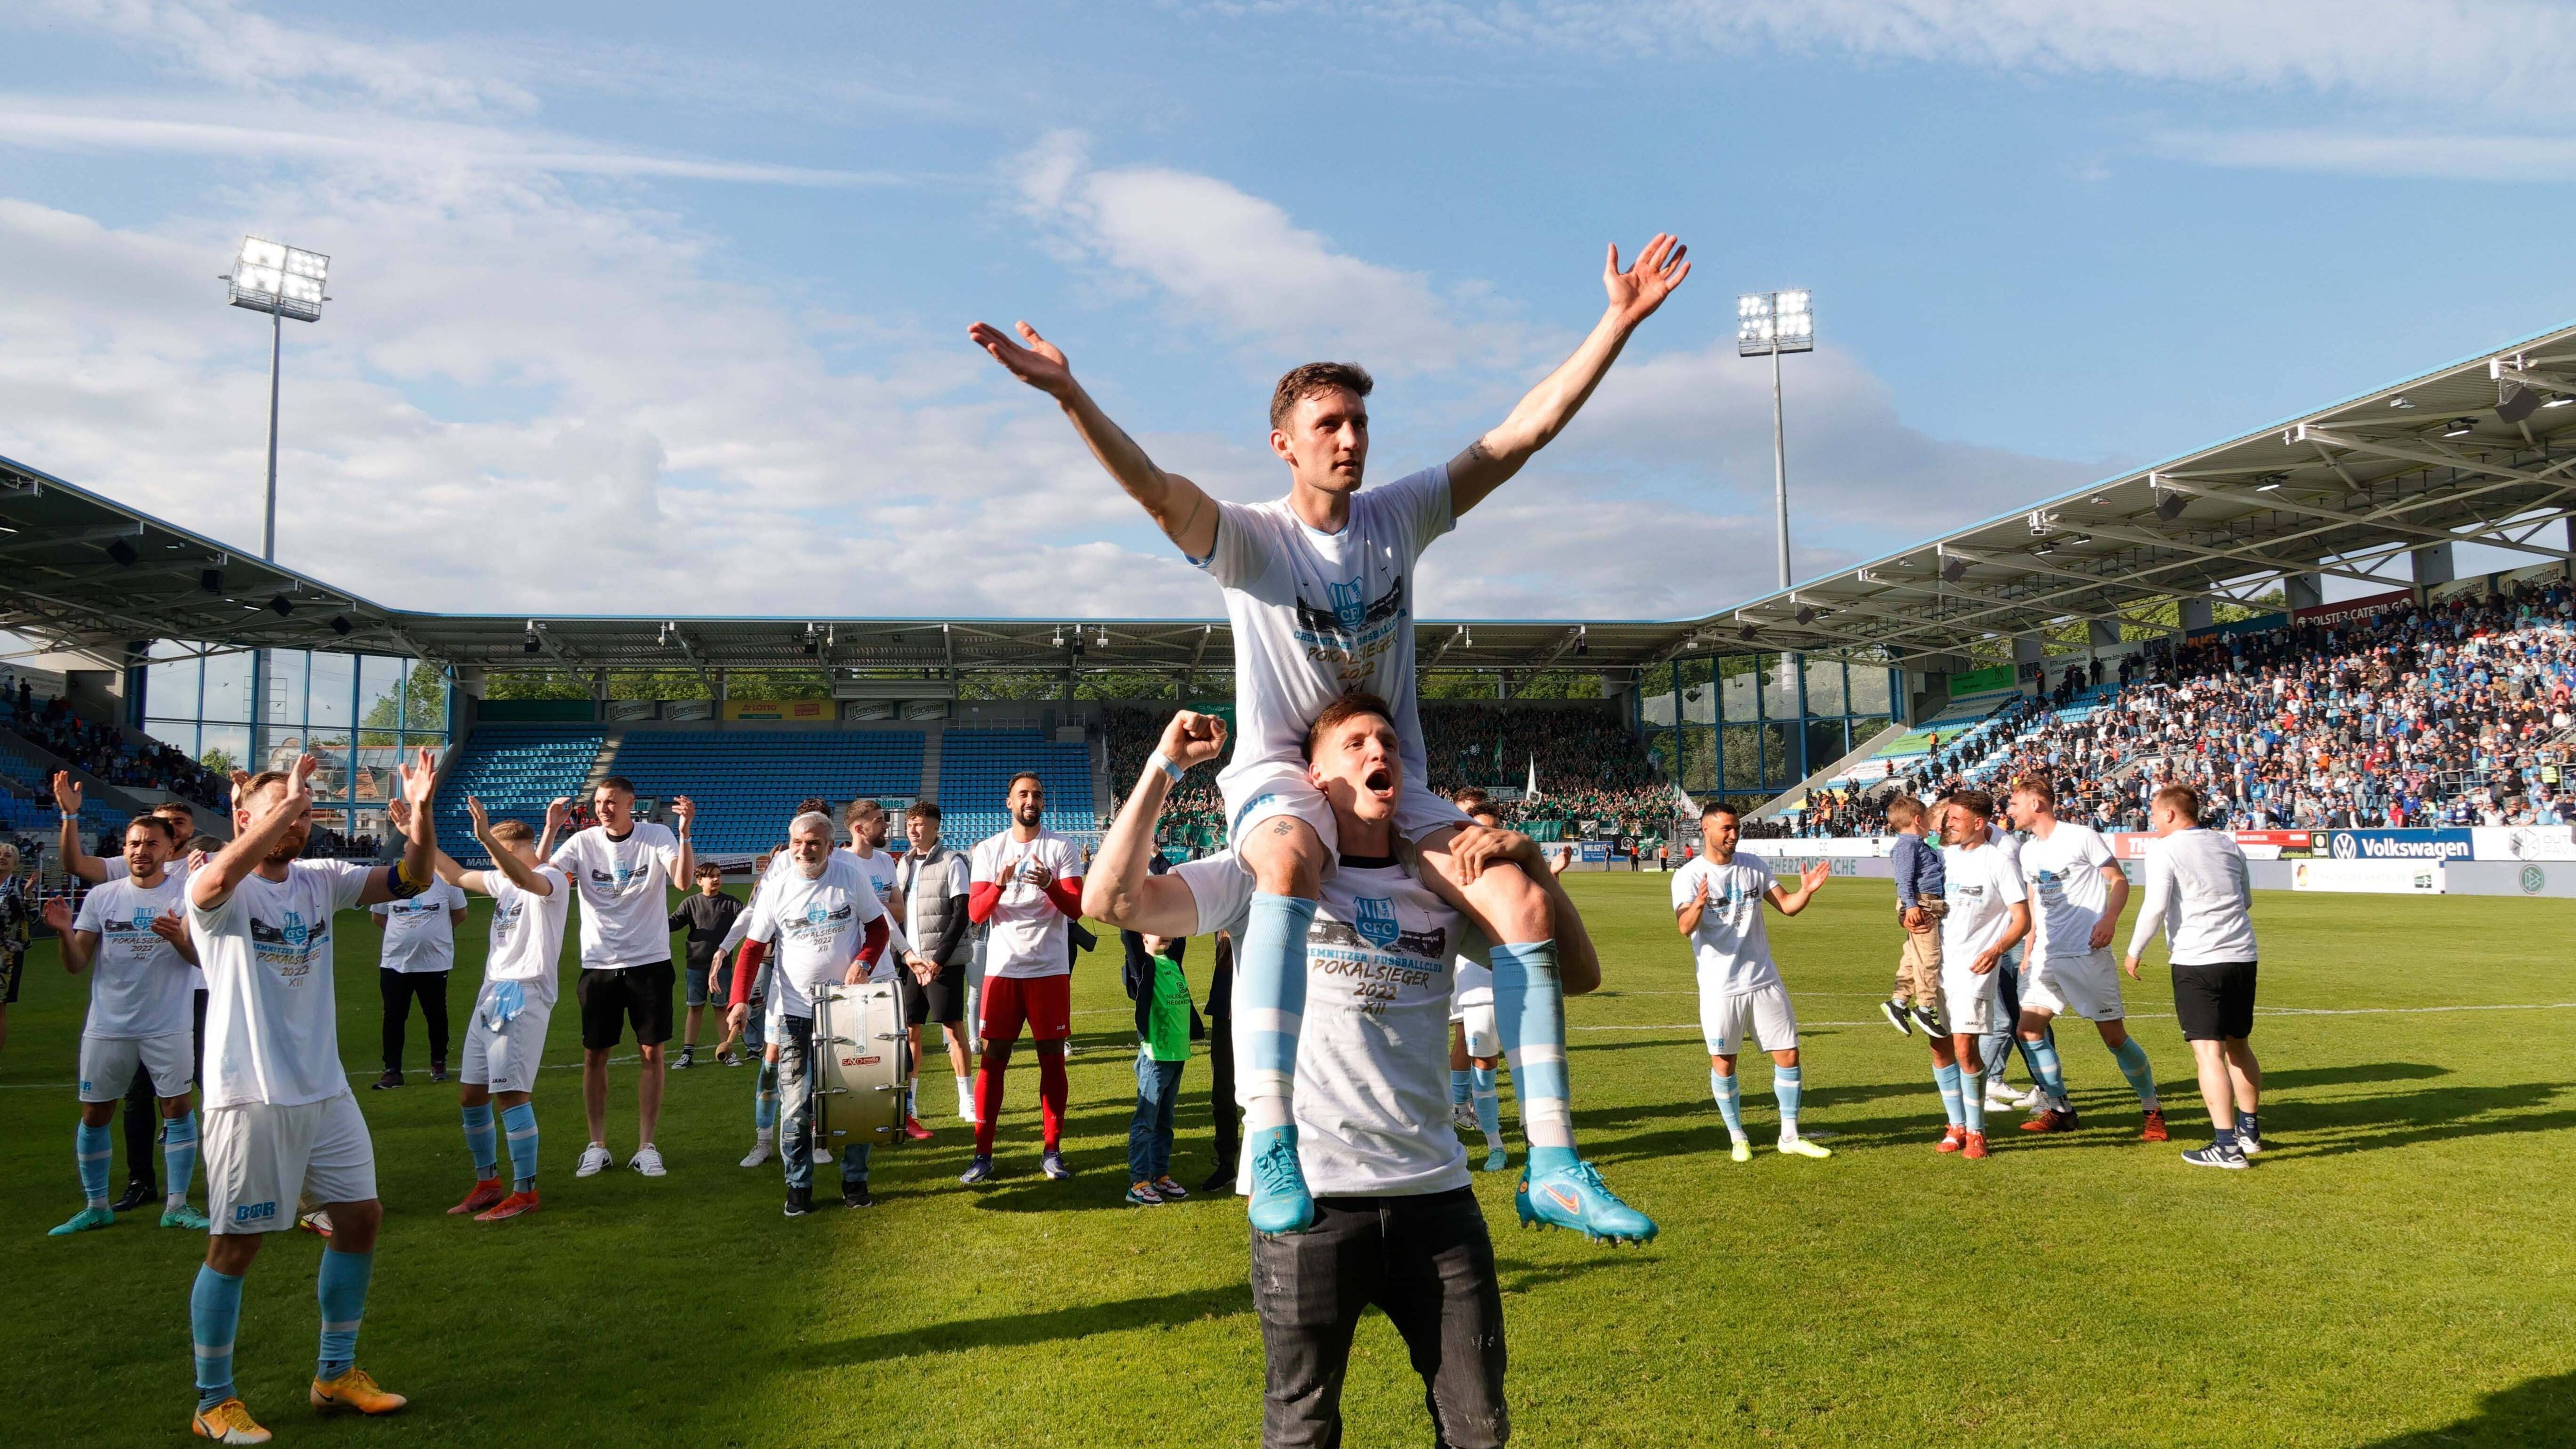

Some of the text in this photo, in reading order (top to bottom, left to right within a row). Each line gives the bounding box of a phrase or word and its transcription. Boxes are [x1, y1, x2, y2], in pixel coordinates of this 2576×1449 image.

[609, 704, 652, 719] Wernesgrüner
[667, 704, 708, 719] Wernesgrüner
[849, 703, 889, 719] Wernesgrüner
[904, 703, 944, 719] Wernesgrüner
[1552, 847, 1579, 857] JAO
[2361, 838, 2469, 860] Volkswagen
[1362, 922, 1393, 935] CFC
[814, 936, 832, 946] 2022
[1307, 947, 1443, 973] EMNITZER FUSSBALLCLUB
[281, 965, 309, 976] 2022
[1312, 958, 1430, 989] POKALSIEGER
[289, 977, 304, 987] XII
[1353, 981, 1397, 1000] 2022
[1361, 1000, 1386, 1015] XII
[236, 1201, 276, 1220] BTR
